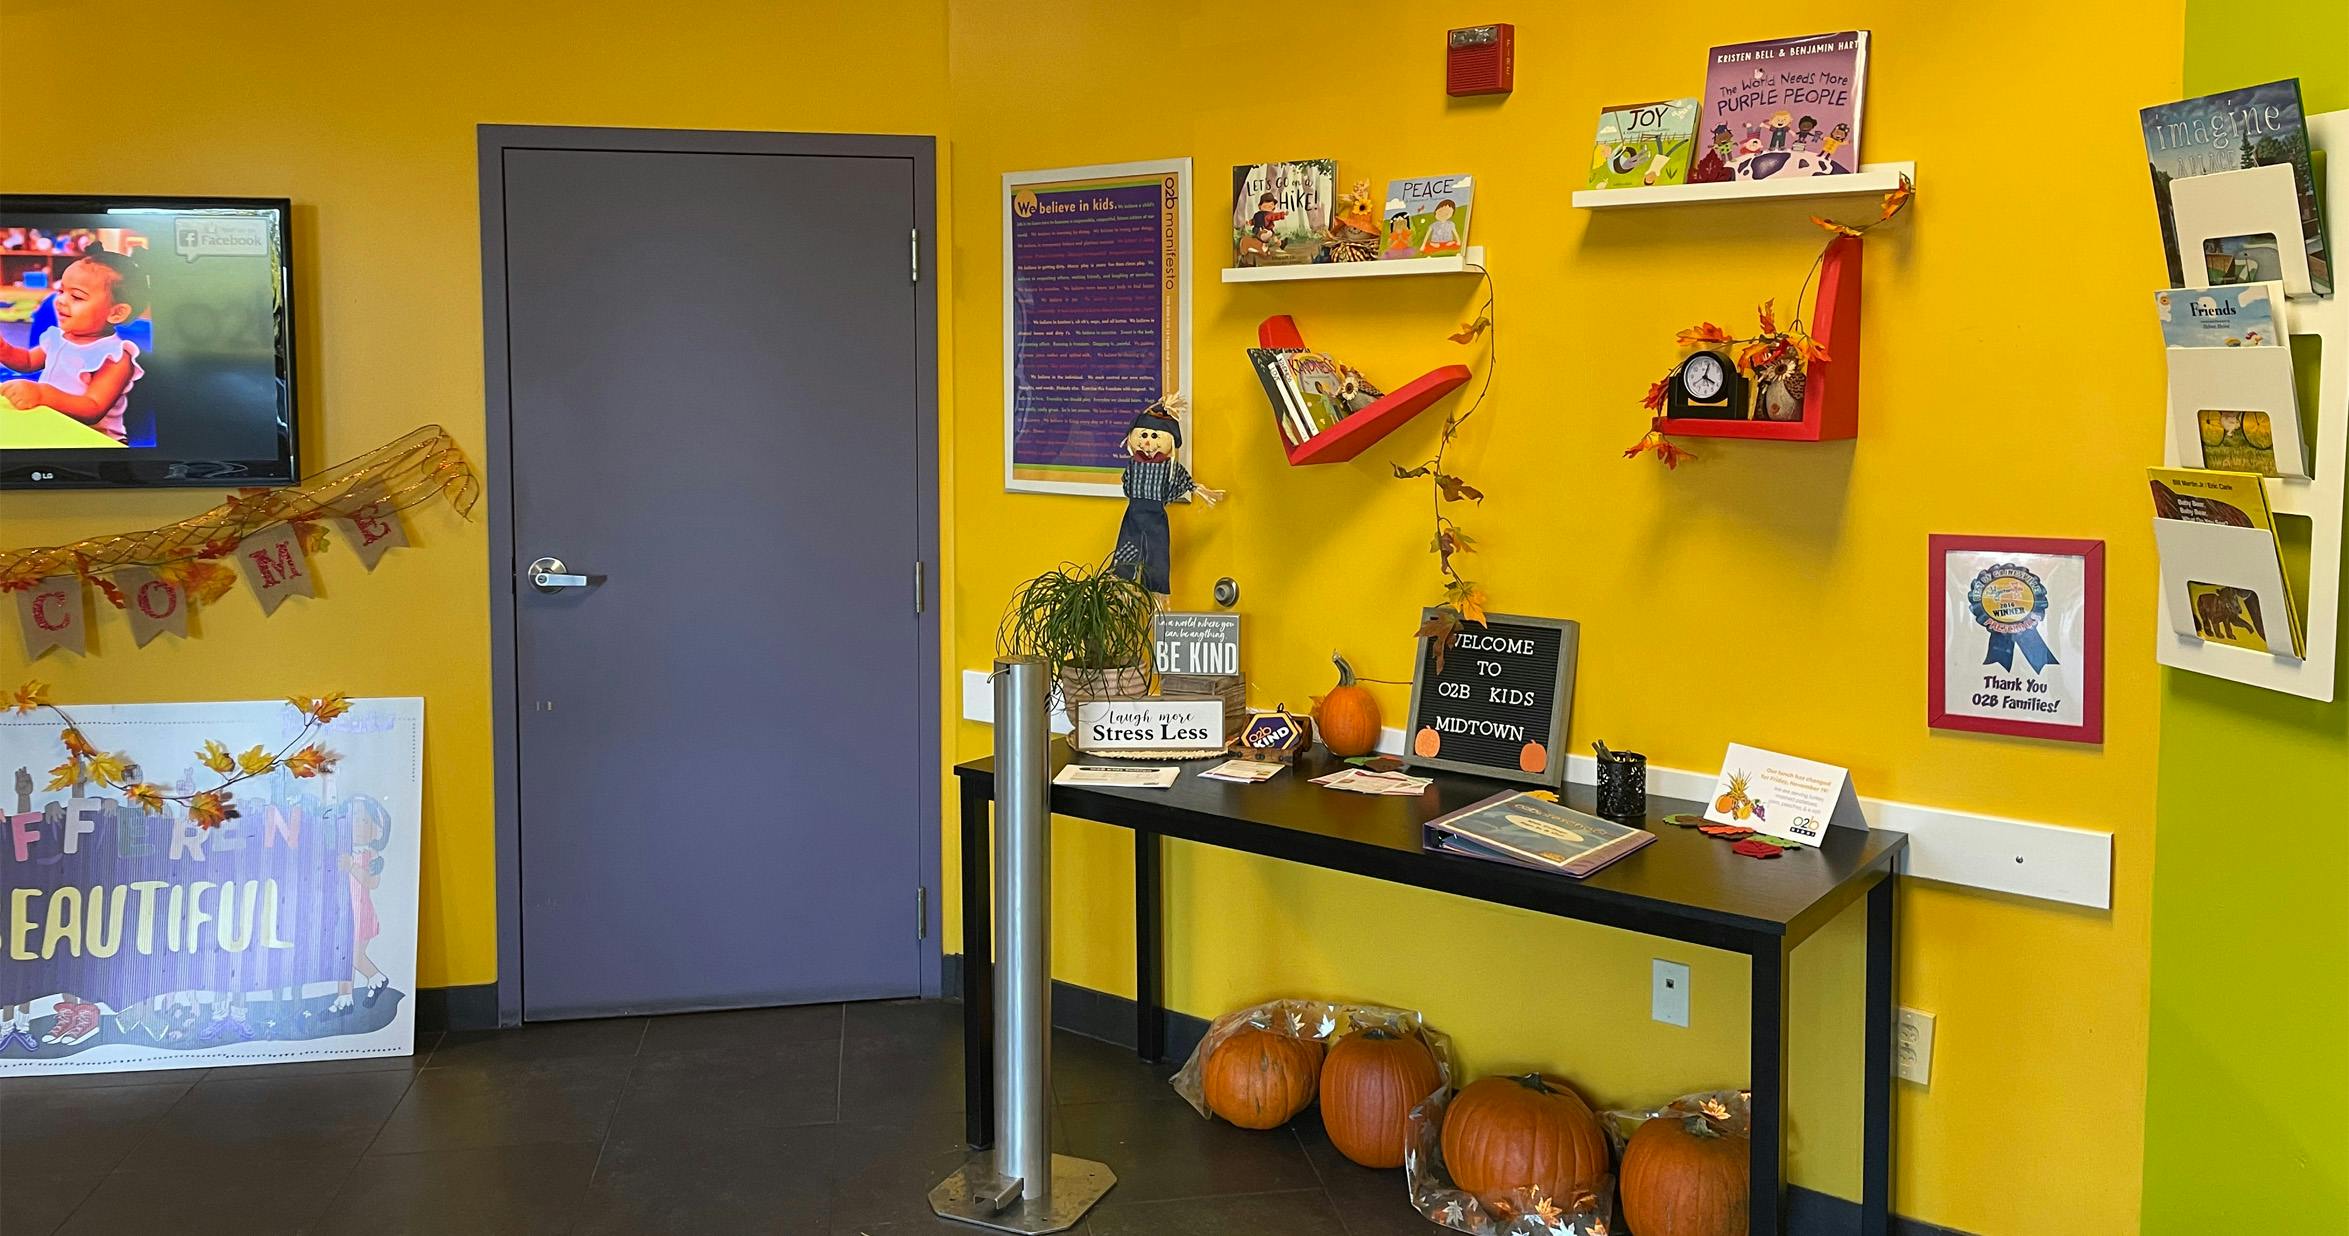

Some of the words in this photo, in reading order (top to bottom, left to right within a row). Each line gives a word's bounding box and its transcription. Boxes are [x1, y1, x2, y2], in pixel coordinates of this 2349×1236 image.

[1717, 52, 1752, 64] KRISTEN
[1755, 48, 1775, 60] BELL
[1778, 48, 1786, 58] &
[1790, 43, 1834, 56] BENJAMIN
[1838, 40, 1860, 50] HART
[1720, 86, 1737, 97] The
[1741, 76, 1776, 92] World
[1780, 72, 1816, 86] Needs
[1820, 72, 1849, 86] More
[1717, 89, 1779, 116] PURPLE
[1783, 88, 1848, 106] PEOPLE
[1627, 107, 1669, 131] JOY
[2155, 99, 2281, 150] imagine
[1246, 178, 1272, 197] LET'S
[1275, 177, 1289, 188] GO
[1402, 179, 1455, 200] PEACE
[1018, 201, 1036, 215] We
[1039, 201, 1076, 215] believe
[1079, 200, 1089, 211] in
[1093, 197, 1117, 210] kids.
[201, 234, 262, 247] Facebook
[1165, 212, 1177, 290] manifesto
[2189, 299, 2237, 317] Friends
[42, 472, 53, 480] LG
[1993, 608, 2025, 617] WINNER
[1175, 617, 1198, 628] world
[1197, 617, 1220, 628] where
[1221, 621, 1235, 632] you
[1180, 628, 1189, 637] be
[1156, 641, 1181, 672] BE
[1189, 642, 1237, 674] KIND
[1476, 660, 1502, 677] TO
[1438, 682, 1471, 699] O2B
[1488, 686, 1535, 706] KIDS
[1983, 675, 2022, 692] Thank
[2026, 678, 2048, 693] You
[1972, 693, 1999, 707] O2B
[2002, 695, 2061, 713] Families!
[1158, 713, 1195, 725] more
[1435, 716, 1525, 742] MIDTOWN
[1093, 724, 1154, 741] Stress
[1160, 724, 1208, 740] Less
[1253, 727, 1290, 748] KIND
[0, 878, 295, 962] EAUTIFUL
